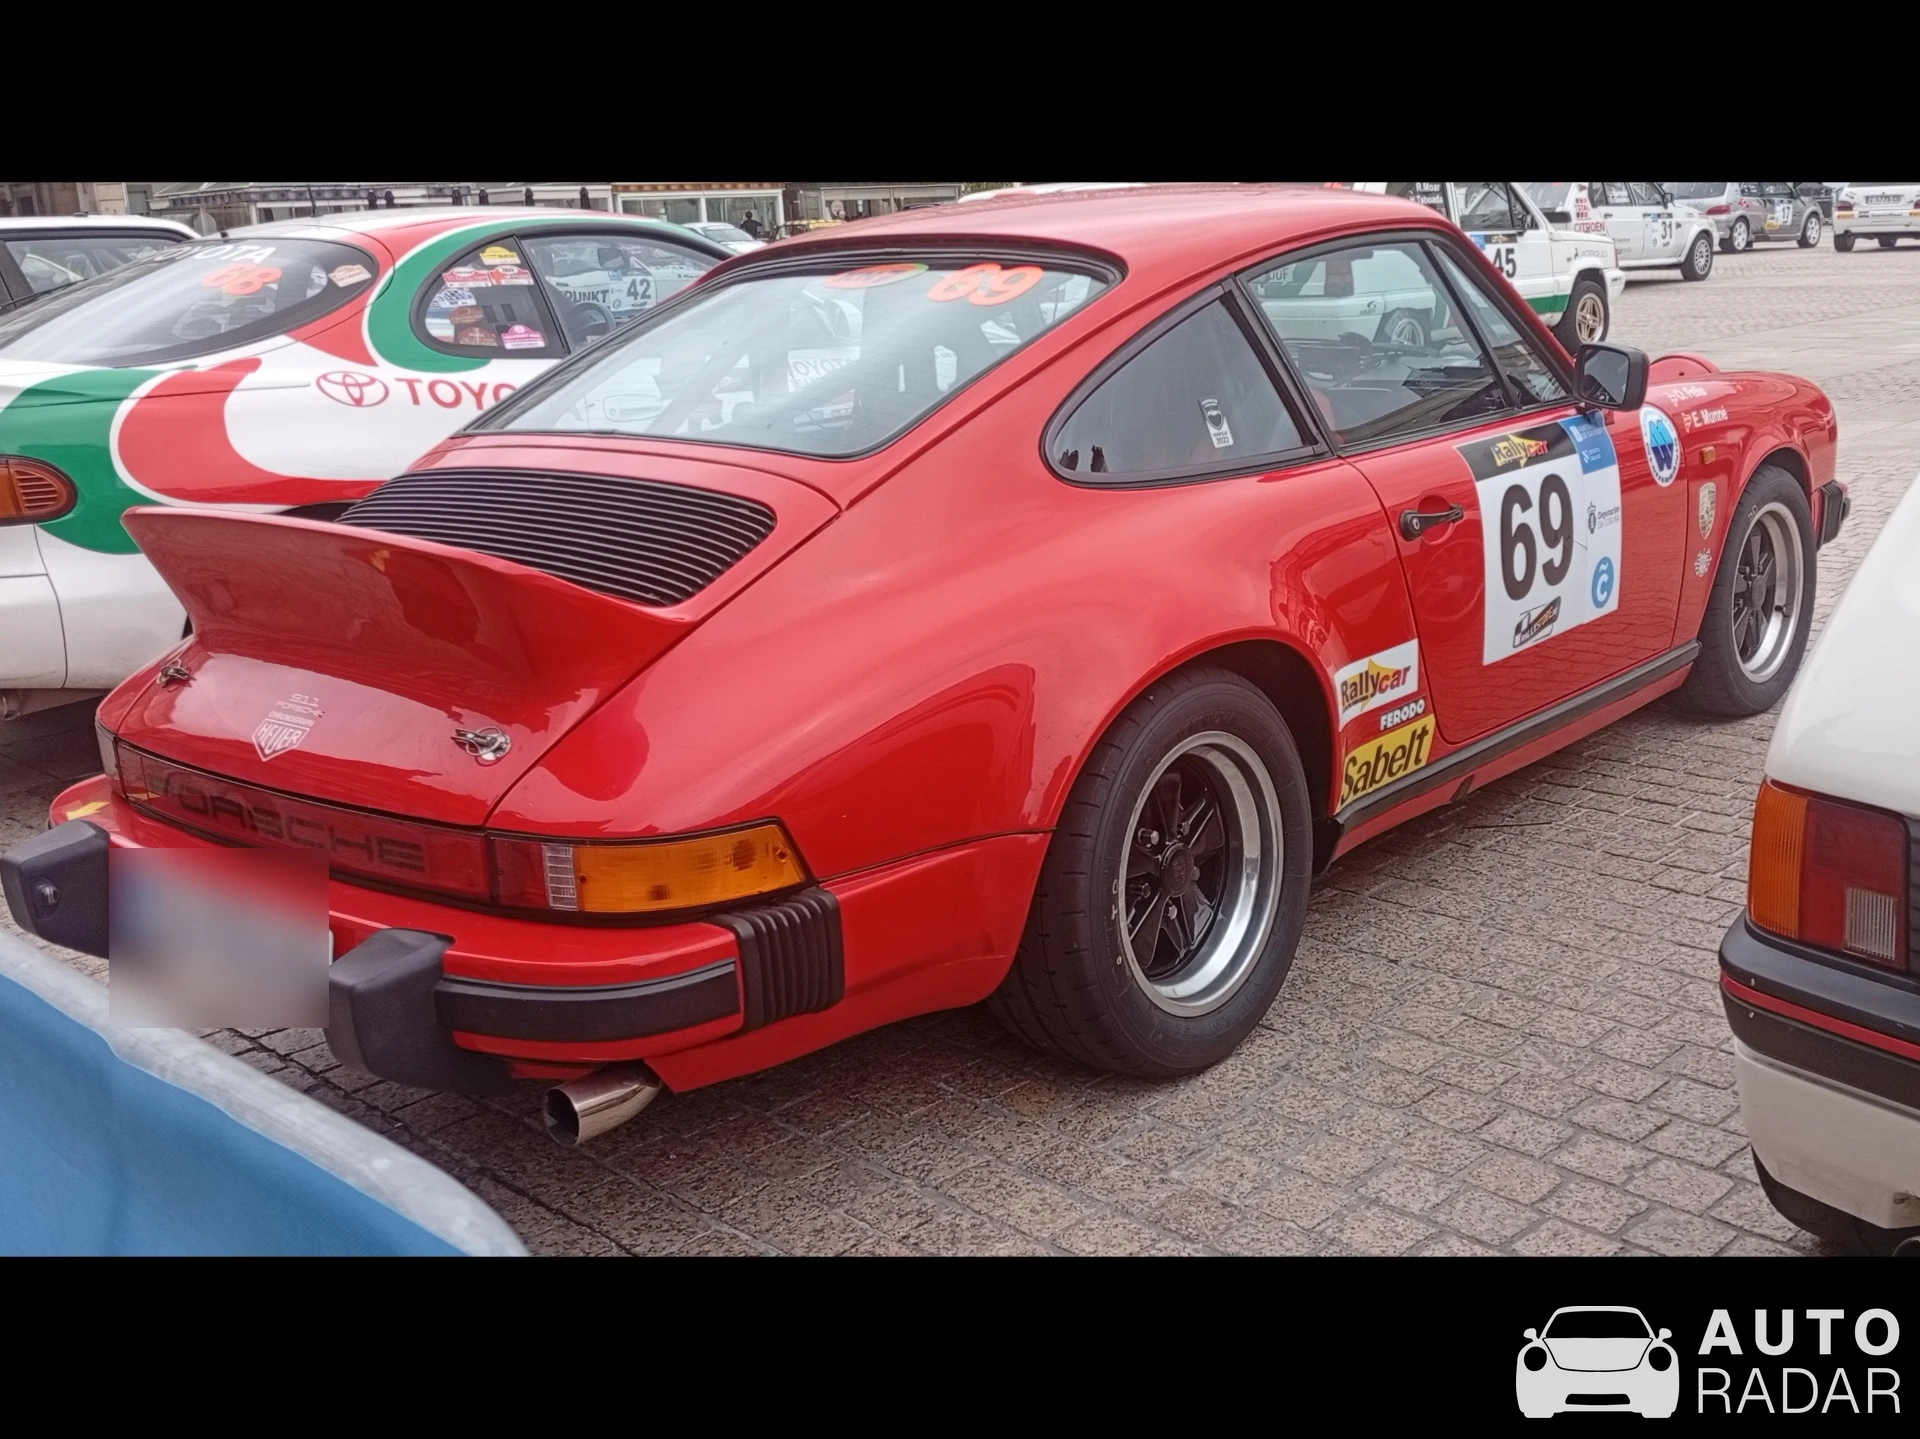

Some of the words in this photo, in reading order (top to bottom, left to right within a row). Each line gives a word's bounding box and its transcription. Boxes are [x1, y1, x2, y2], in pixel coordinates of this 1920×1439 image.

[1661, 220, 1673, 240] 31
[200, 263, 283, 295] 68
[1493, 248, 1517, 278] 45
[627, 279, 652, 301] 42
[928, 262, 1044, 307] 69
[395, 377, 518, 411] TOYO
[1490, 440, 1549, 461] Rallycar
[1500, 474, 1573, 601] 69
[1341, 665, 1411, 707] Rallycar
[1381, 698, 1426, 731] FERODO
[257, 722, 304, 755] HEUER
[1341, 723, 1430, 806] Sabelt
